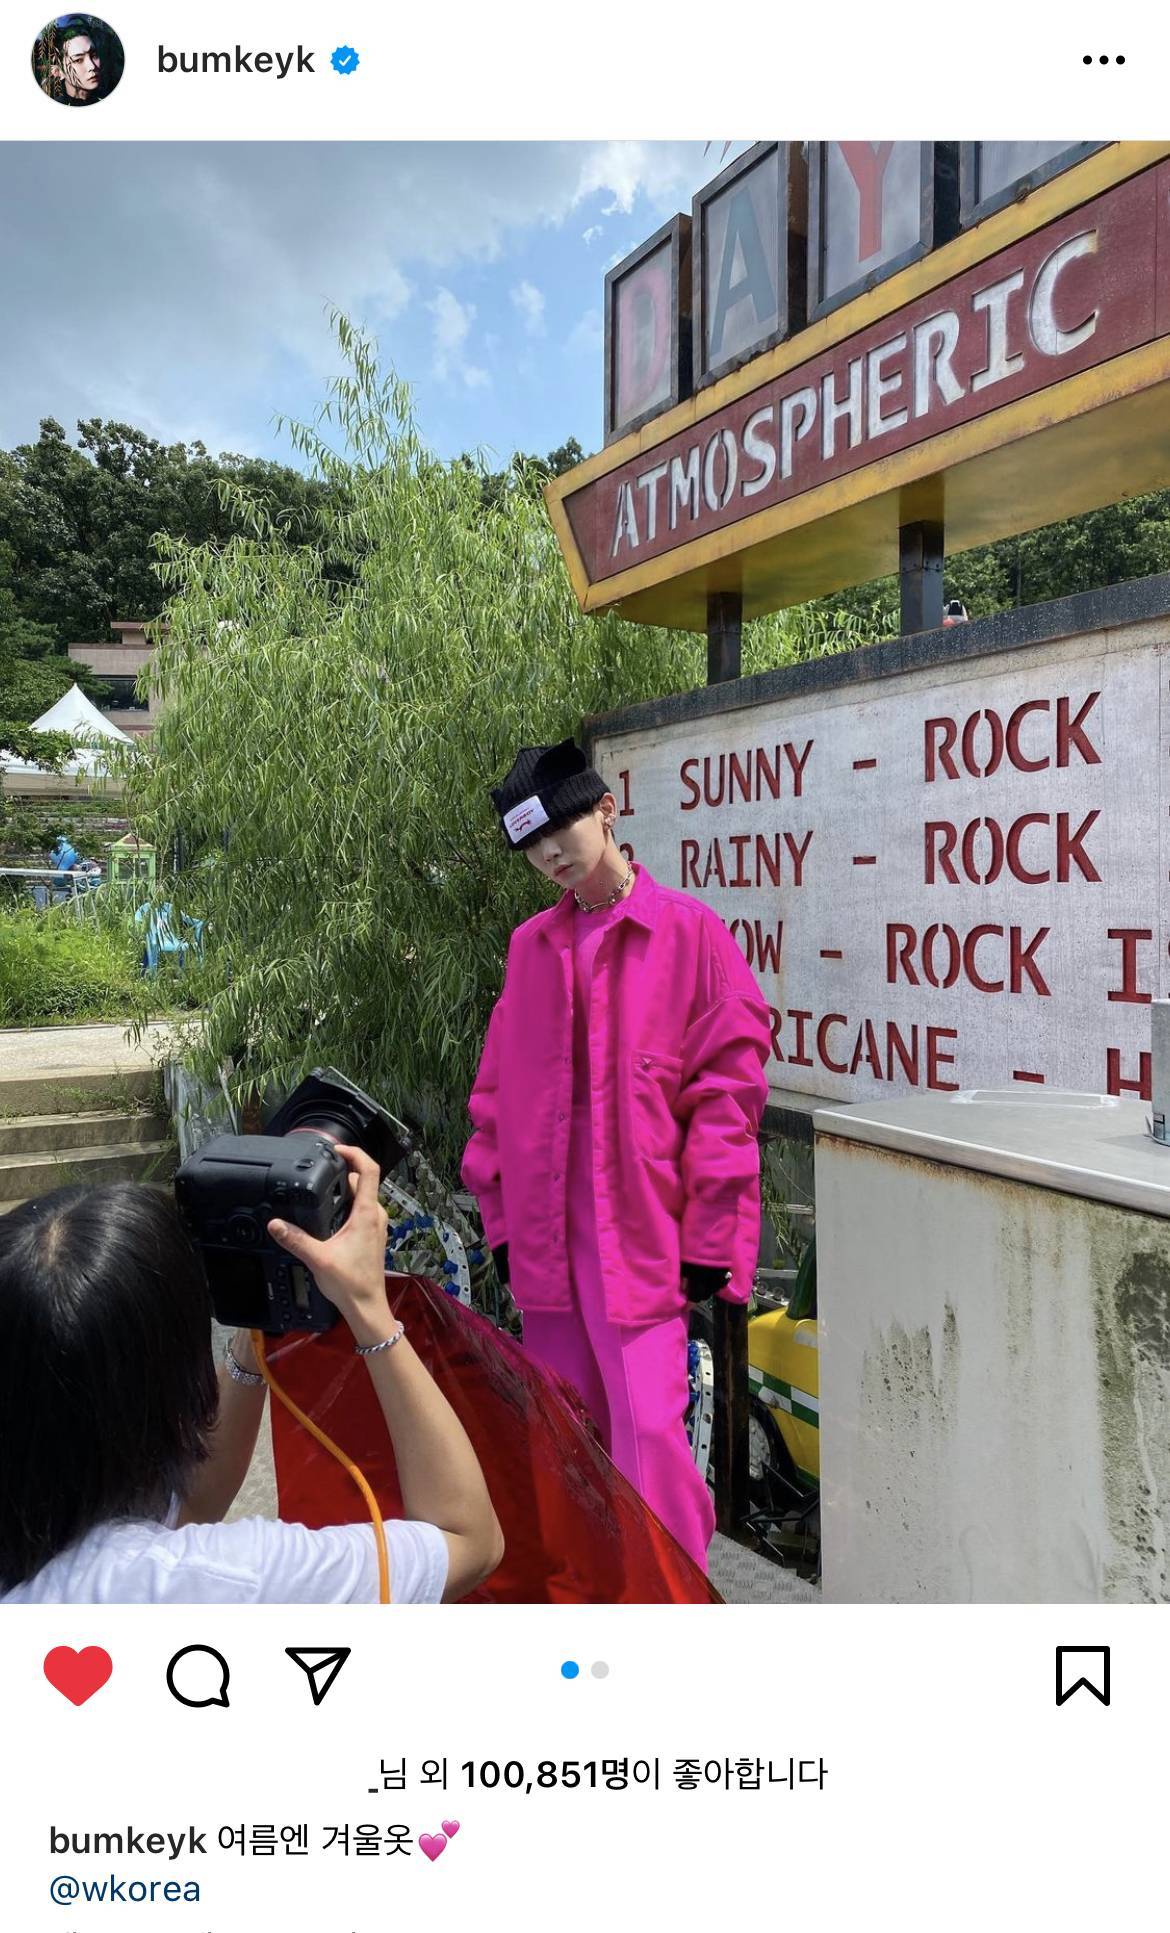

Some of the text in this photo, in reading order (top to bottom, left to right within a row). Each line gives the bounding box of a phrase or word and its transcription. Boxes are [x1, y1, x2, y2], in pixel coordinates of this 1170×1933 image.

[611, 229, 1099, 559] ATMOSPHERIC
[619, 769, 635, 817] 1
[680, 739, 815, 811] SUNNY
[924, 691, 1103, 783] ROCK
[681, 830, 814, 888] RAINY
[924, 809, 1103, 885] ROCK
[886, 922, 1052, 997] ROCK
